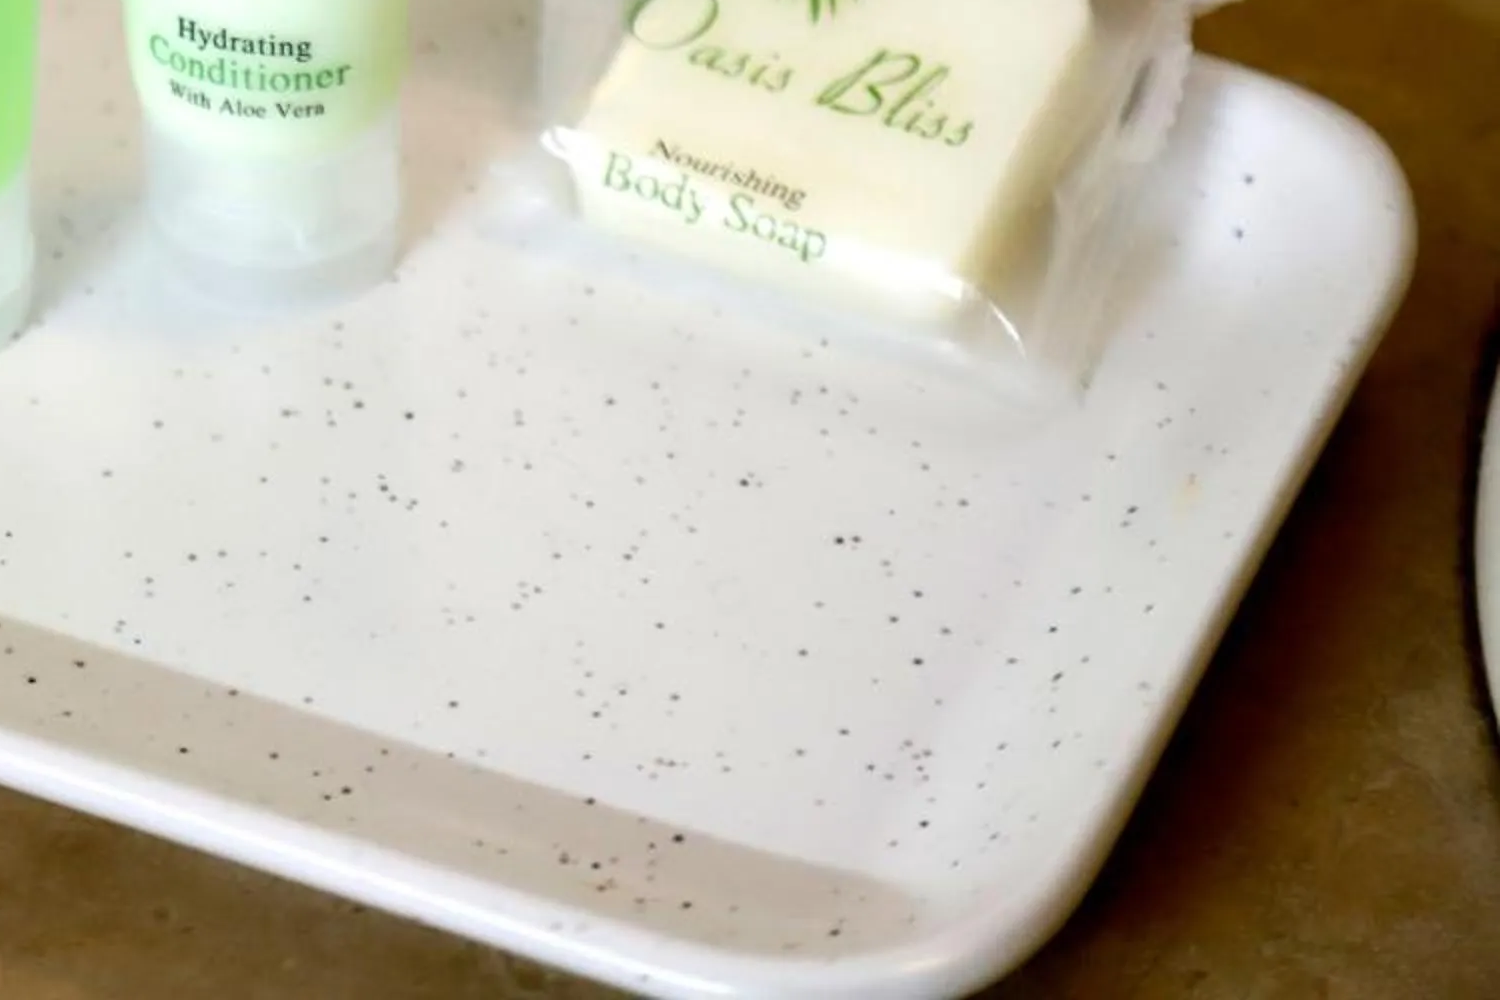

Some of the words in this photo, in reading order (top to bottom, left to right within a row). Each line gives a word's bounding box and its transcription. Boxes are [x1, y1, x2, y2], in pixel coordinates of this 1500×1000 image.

[149, 33, 352, 94] Conditioner
[176, 15, 313, 63] Hydrating
[168, 78, 211, 111] With
[218, 98, 267, 120] Aloe
[275, 101, 325, 120] Vera
[812, 47, 975, 148] Bliss
[602, 150, 706, 224] Body
[722, 190, 828, 263] Soap
[647, 137, 808, 212] Nourishing
